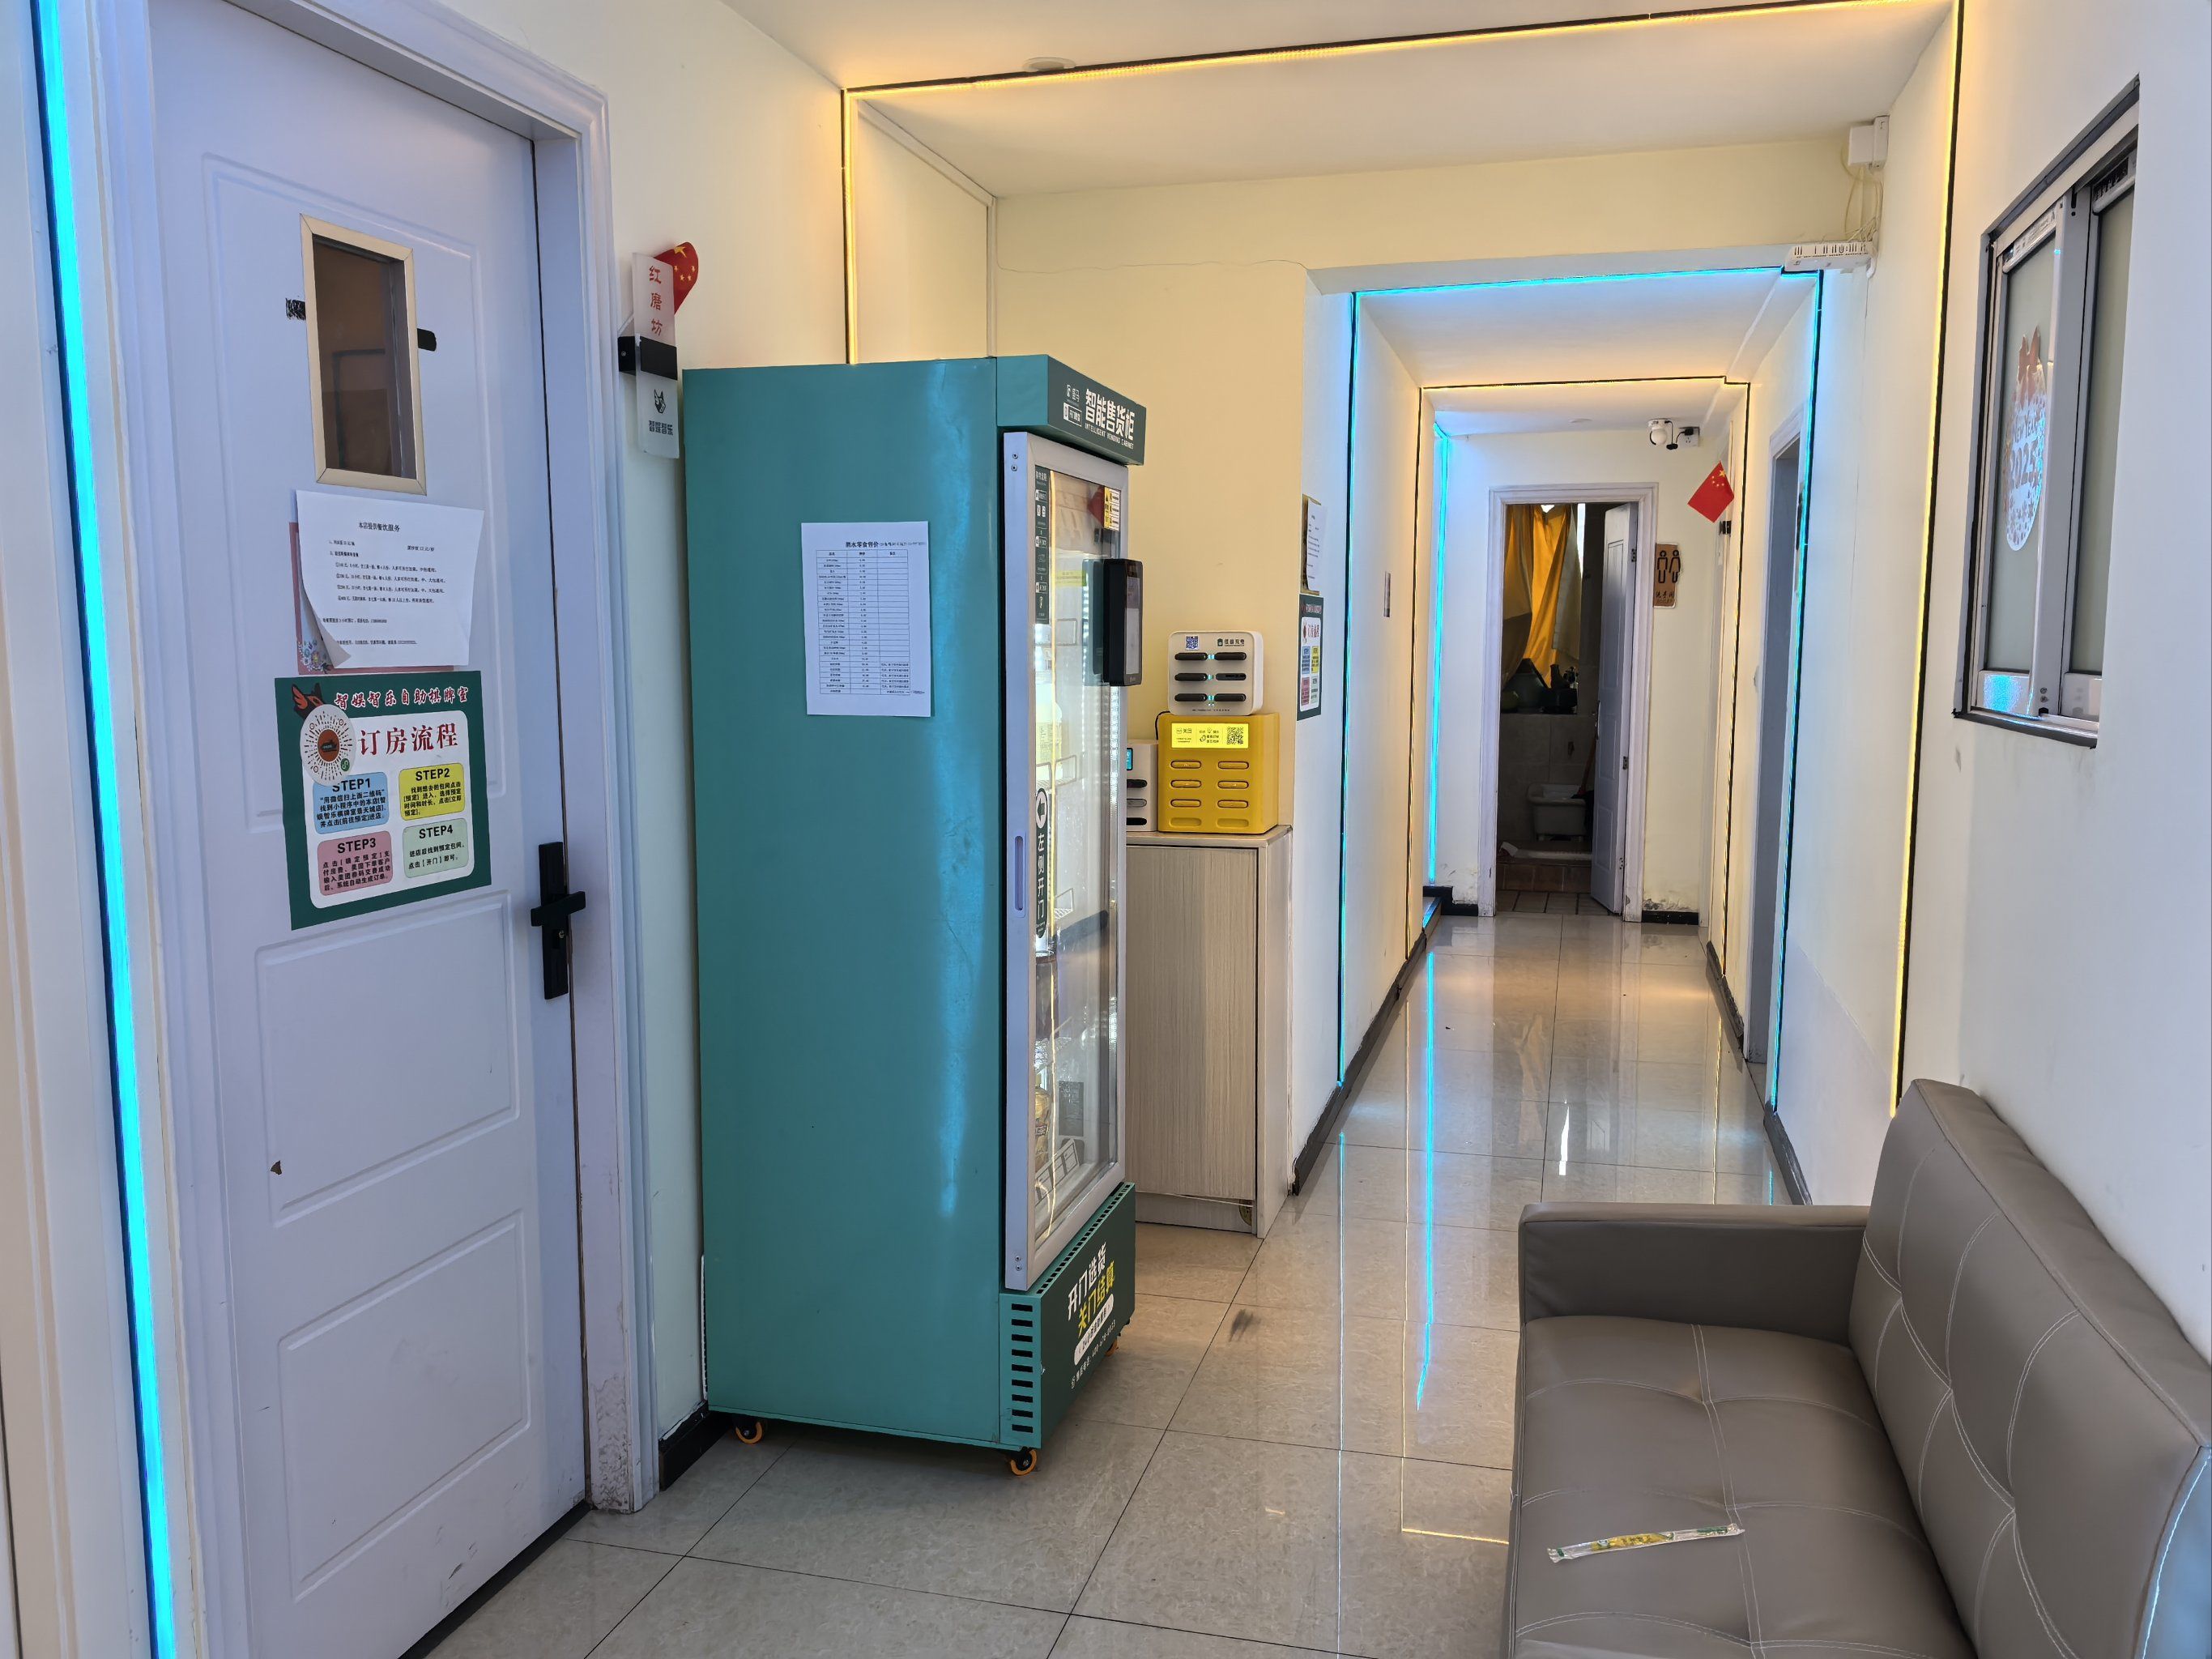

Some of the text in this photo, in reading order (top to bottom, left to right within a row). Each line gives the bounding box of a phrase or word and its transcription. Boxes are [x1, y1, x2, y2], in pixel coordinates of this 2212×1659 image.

[649, 265, 663, 336] 红磨坊
[1085, 388, 1135, 441] 智能售货柜
[334, 686, 468, 710] 智娱智乐自助棋牌室
[358, 723, 458, 755] 订房流程
[332, 778, 370, 792] STEP1
[416, 768, 450, 781] STEP2
[419, 825, 454, 838] STEP4
[337, 838, 376, 854] STEP3
[1068, 1241, 1107, 1321] 开门选货
[1077, 1260, 1116, 1338] 关门结算
